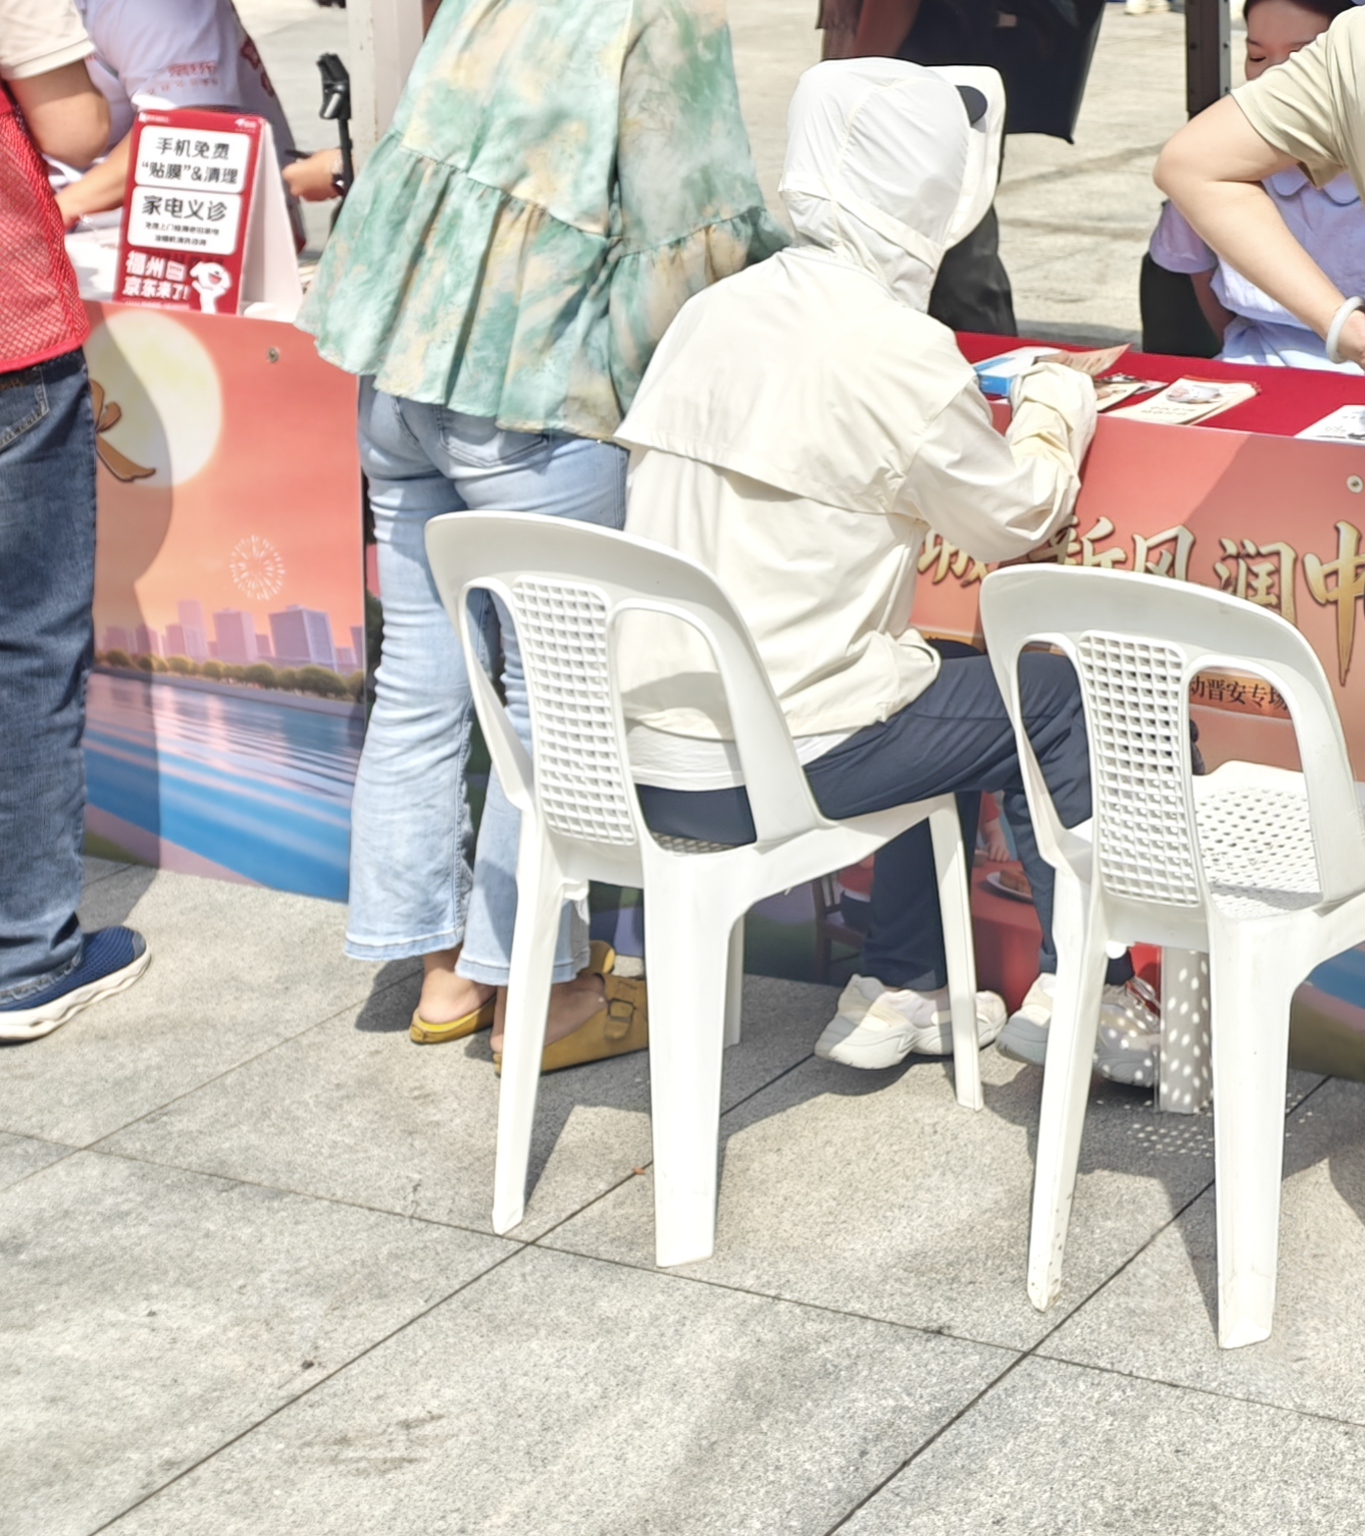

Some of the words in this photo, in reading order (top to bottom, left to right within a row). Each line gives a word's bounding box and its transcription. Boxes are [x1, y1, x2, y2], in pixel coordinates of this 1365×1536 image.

[155, 136, 231, 161] 手机免费
[141, 194, 229, 223] 家电义诊
[125, 249, 167, 281] 福州
